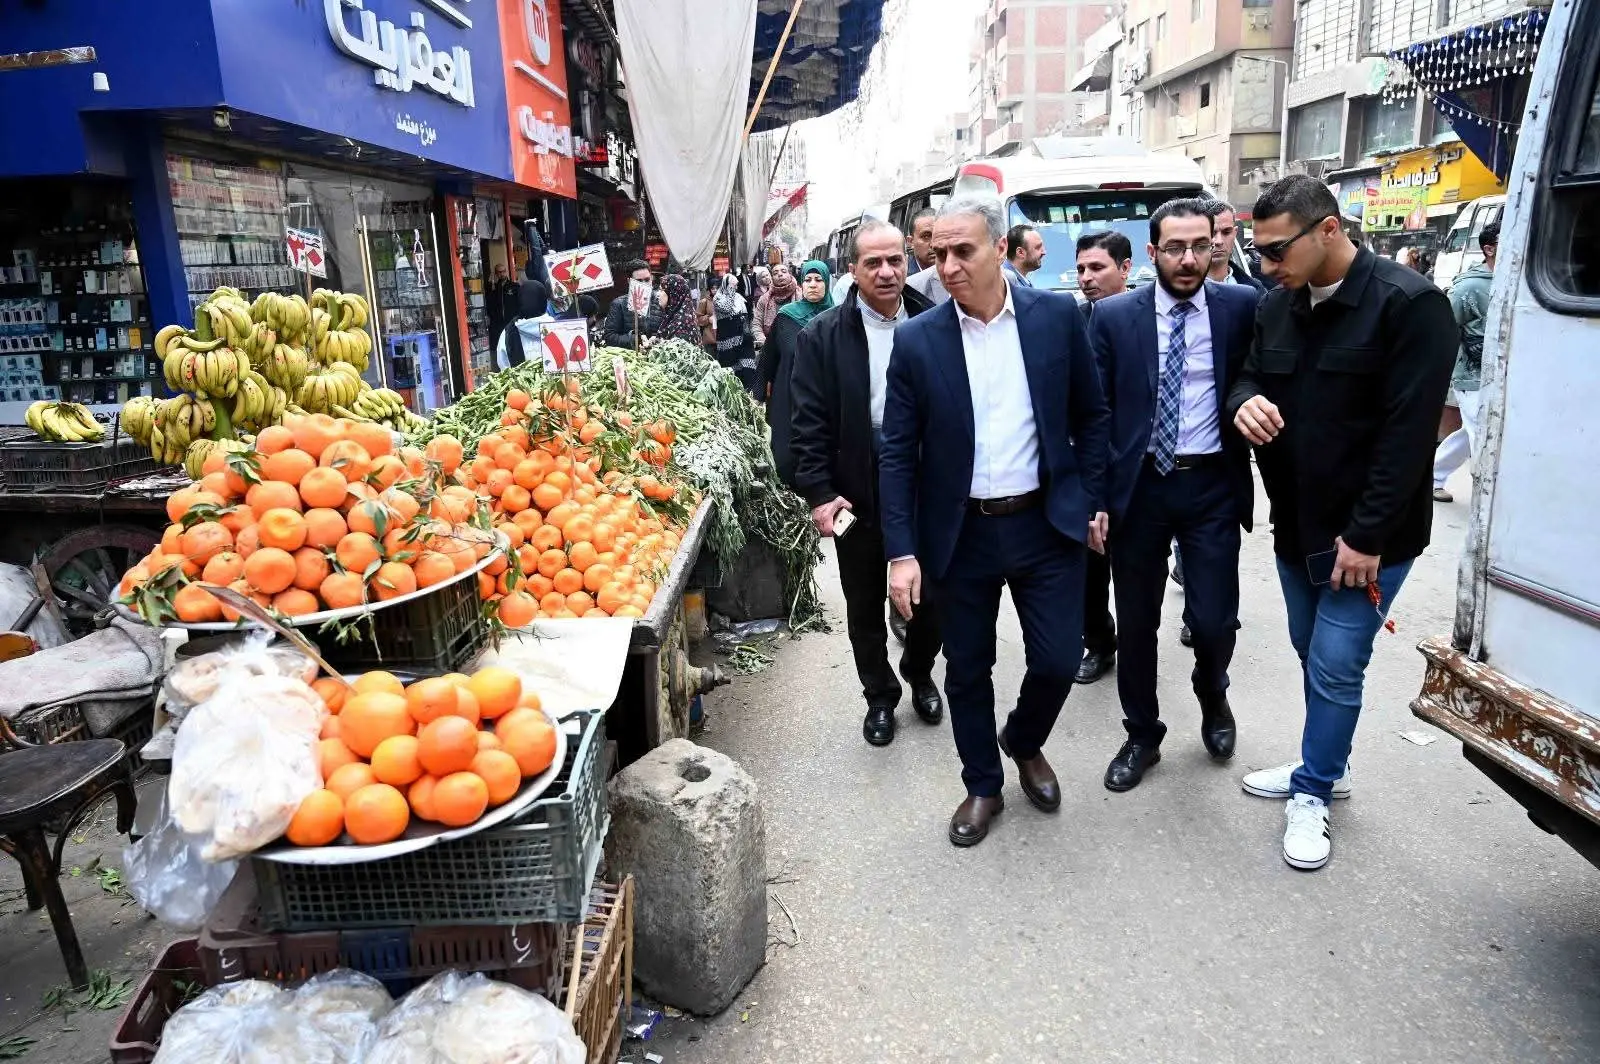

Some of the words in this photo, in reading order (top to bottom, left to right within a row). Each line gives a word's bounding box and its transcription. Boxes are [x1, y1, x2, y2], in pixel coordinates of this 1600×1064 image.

[324, 0, 475, 107] العفريت
[396, 112, 419, 135] معتمد
[420, 120, 437, 146] موزع
[543, 331, 587, 370] ١٥
